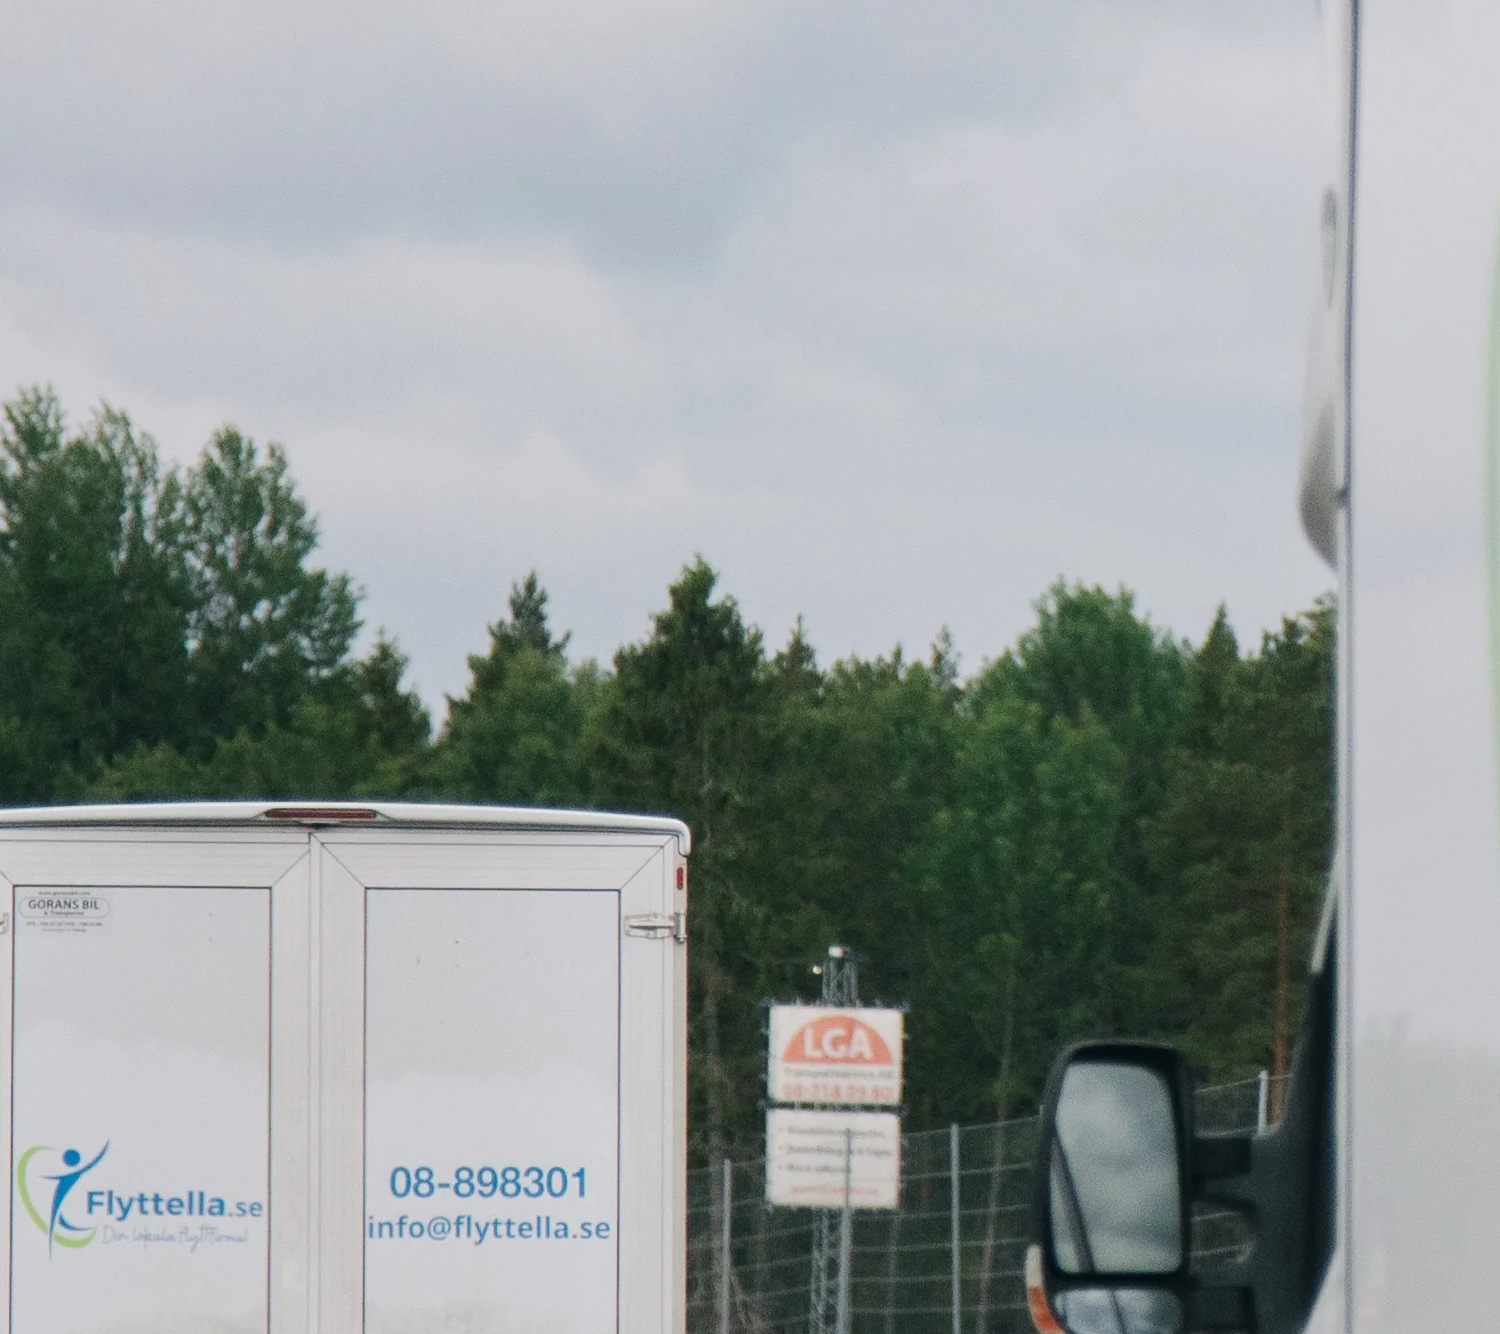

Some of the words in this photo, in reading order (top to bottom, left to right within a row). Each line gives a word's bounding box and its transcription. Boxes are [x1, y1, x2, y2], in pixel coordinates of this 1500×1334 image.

[28, 899, 79, 910] GORANS
[82, 899, 100, 910] BIL
[803, 1027, 872, 1060] LGA
[390, 1166, 586, 1199] 08-898301
[86, 1189, 264, 1221] Flyttella.se
[368, 1214, 611, 1246] info@flyttella.se
